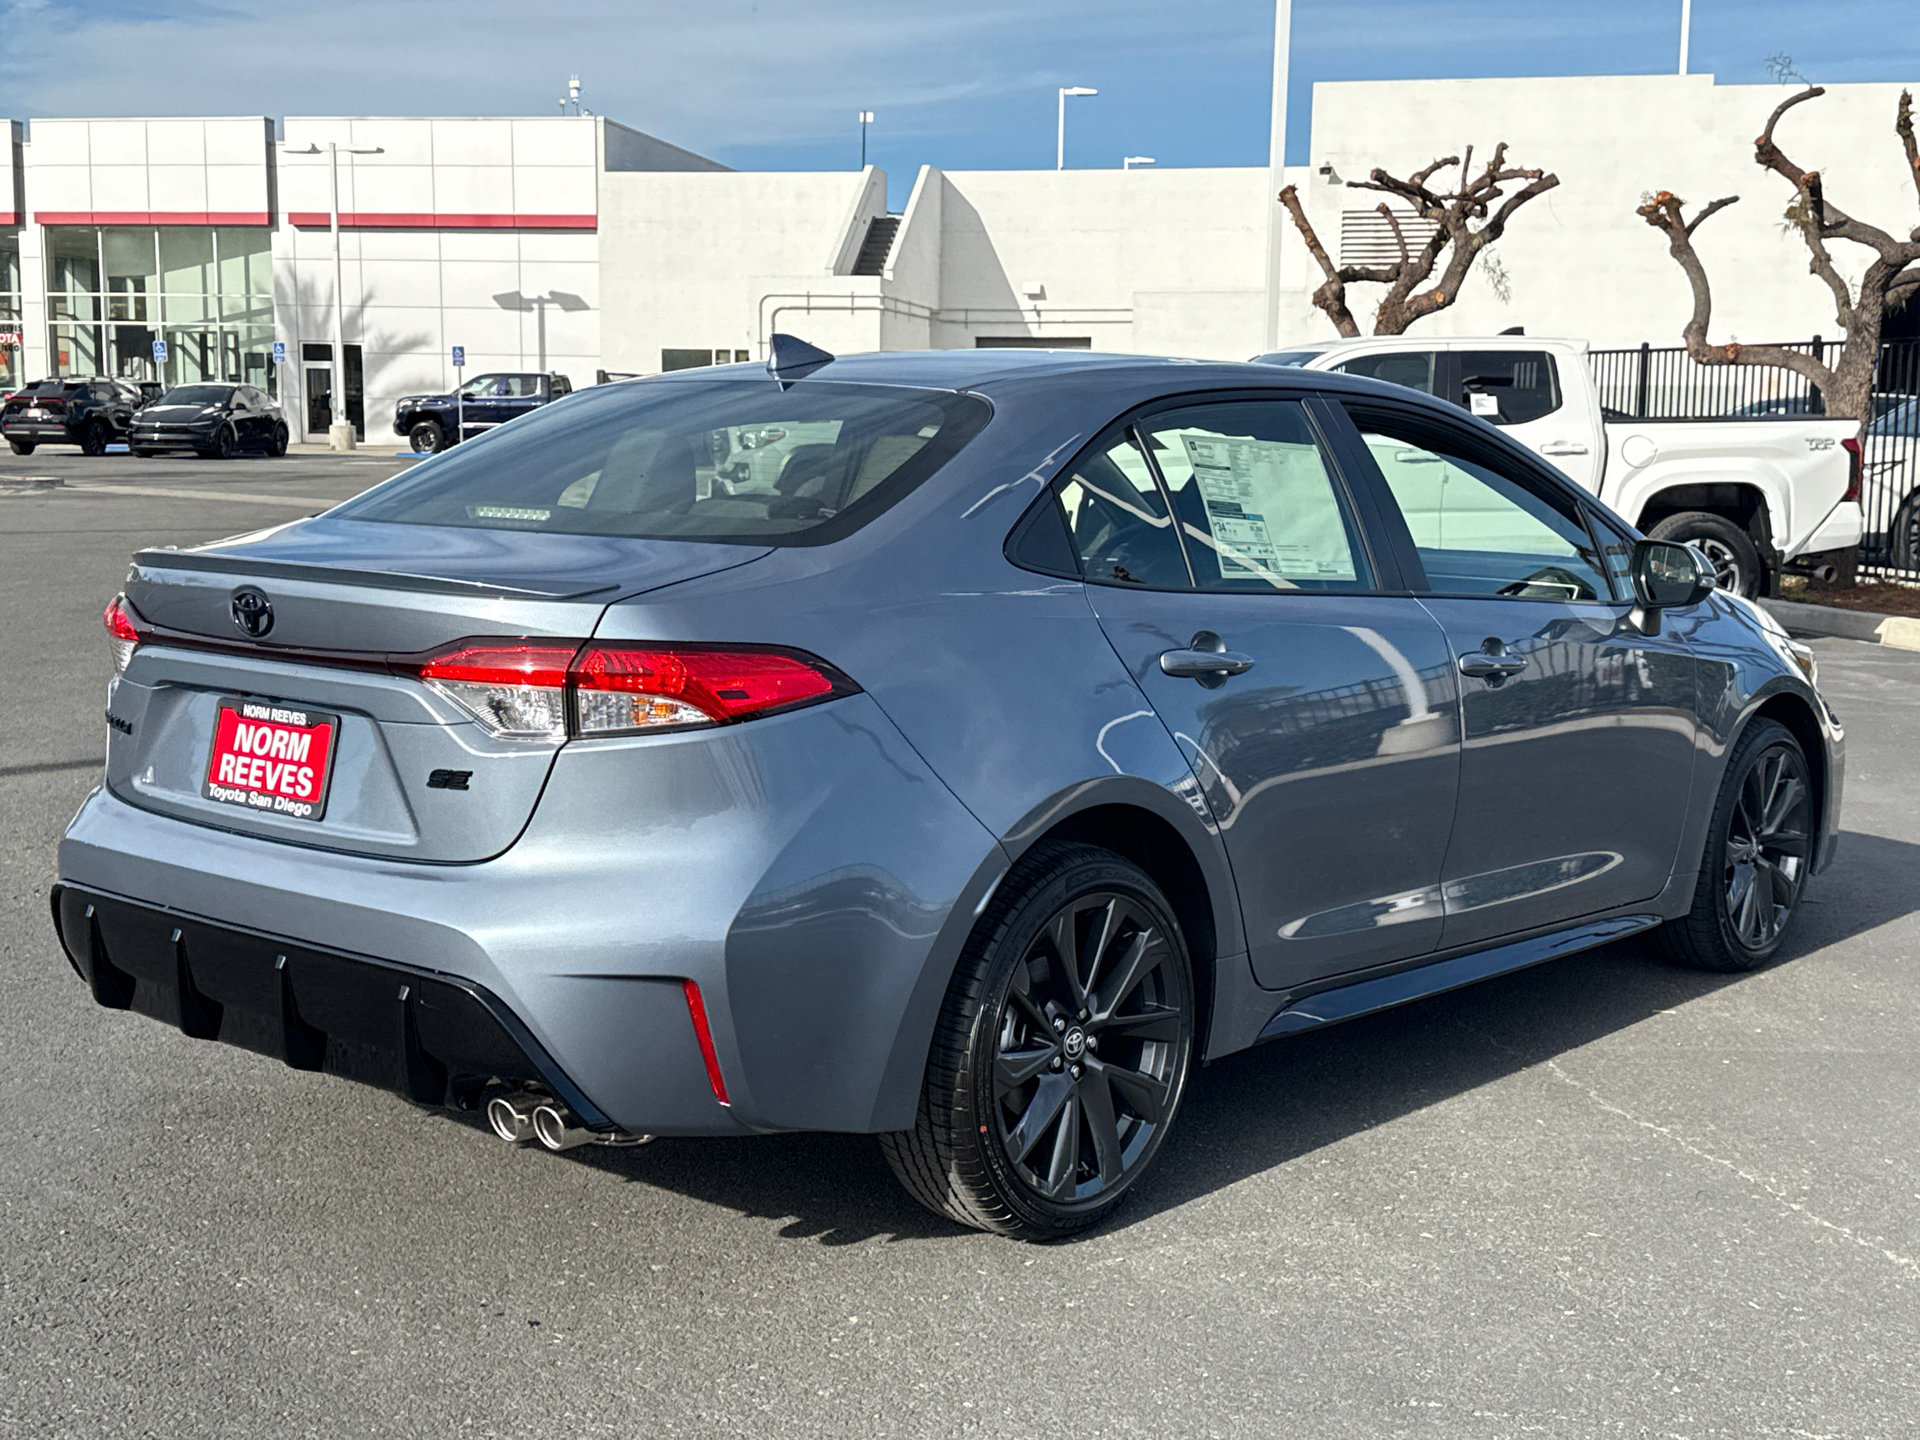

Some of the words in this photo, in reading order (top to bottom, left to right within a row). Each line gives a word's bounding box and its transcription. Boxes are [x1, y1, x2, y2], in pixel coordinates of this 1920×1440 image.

[243, 704, 270, 720] NORM
[271, 709, 307, 726] REEVES
[233, 723, 312, 763] NORM
[218, 753, 314, 797] REEVES
[426, 769, 473, 791] SE
[209, 783, 247, 802] Toyota
[248, 791, 272, 808] San
[274, 797, 312, 817] Diego
